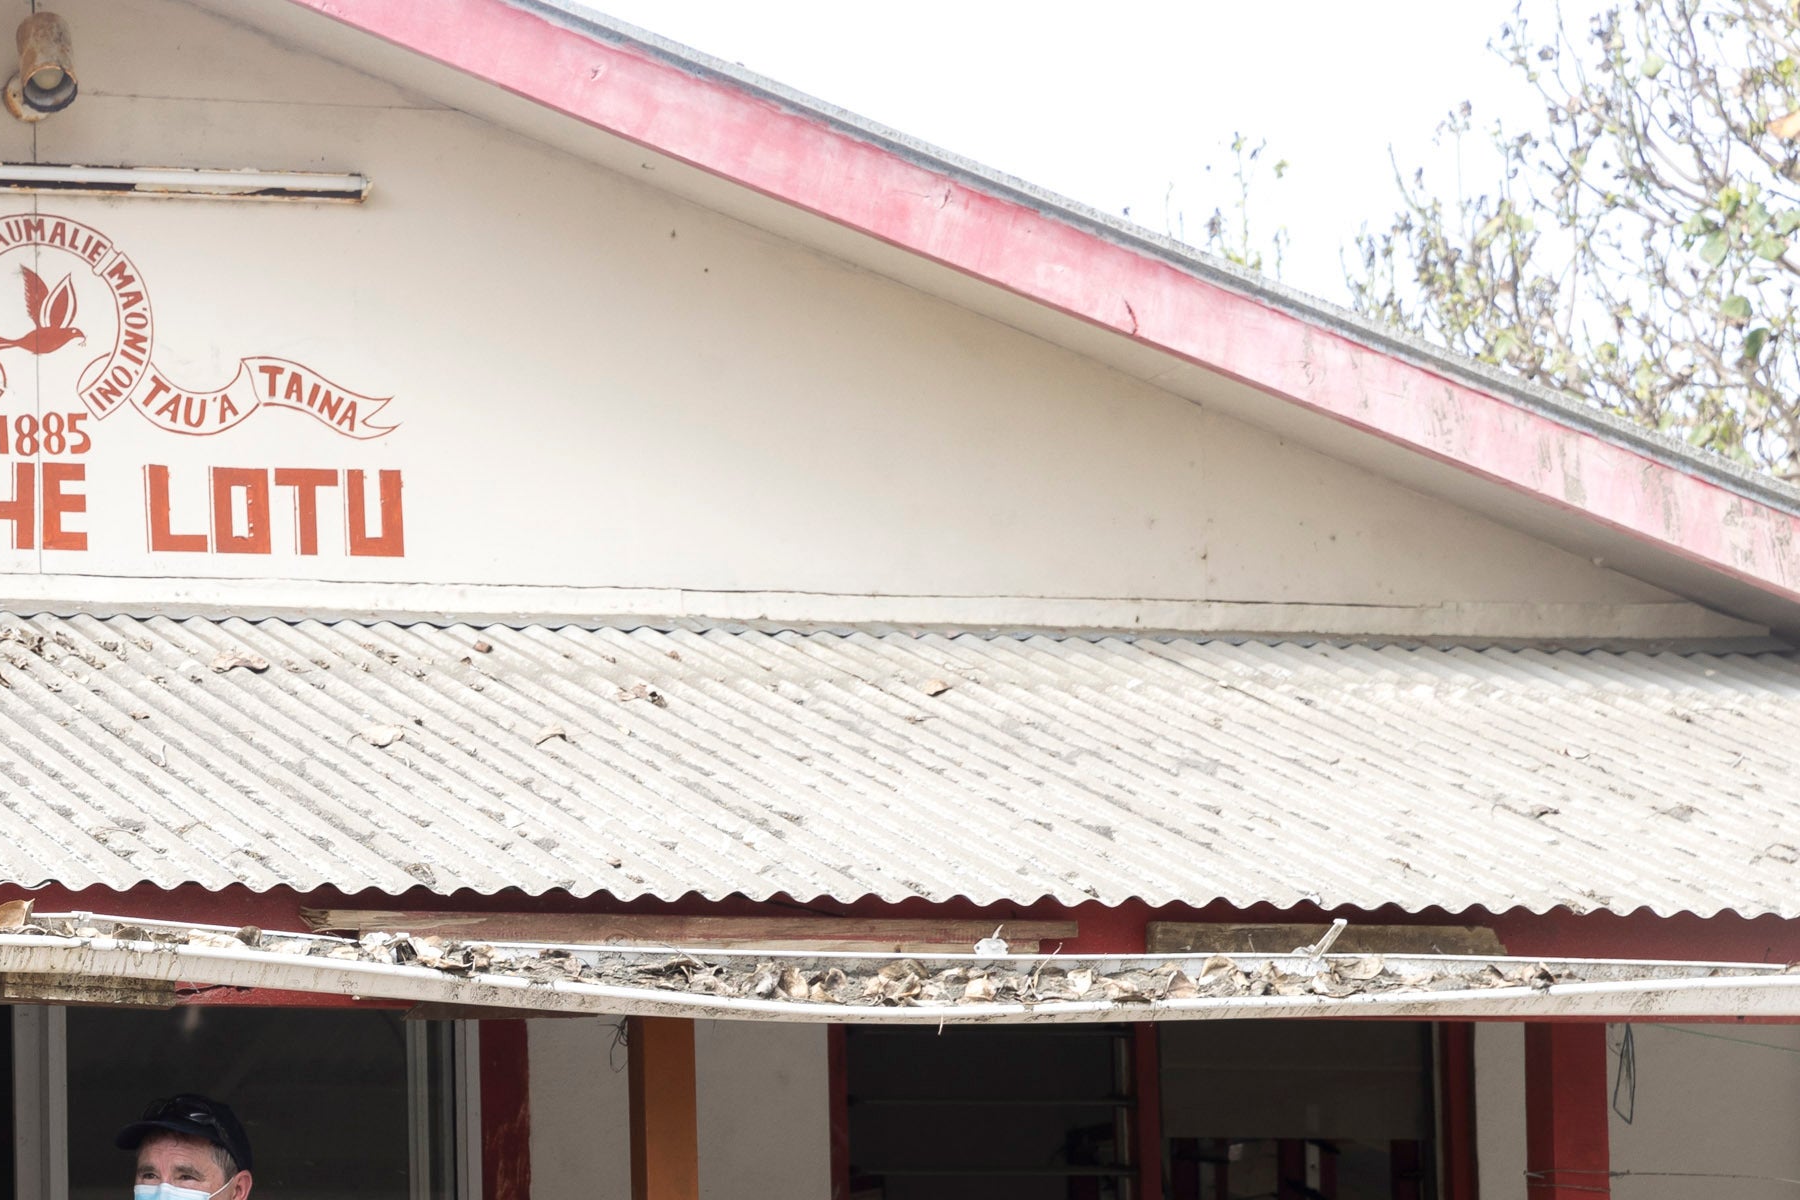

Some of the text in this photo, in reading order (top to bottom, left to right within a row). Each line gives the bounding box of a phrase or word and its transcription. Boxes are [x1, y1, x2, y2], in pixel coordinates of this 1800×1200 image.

[88, 260, 149, 412] MA'ONI'ONI
[142, 375, 239, 428] TAU'A
[258, 365, 358, 432] TAINA
[143, 463, 405, 558] LOTU
